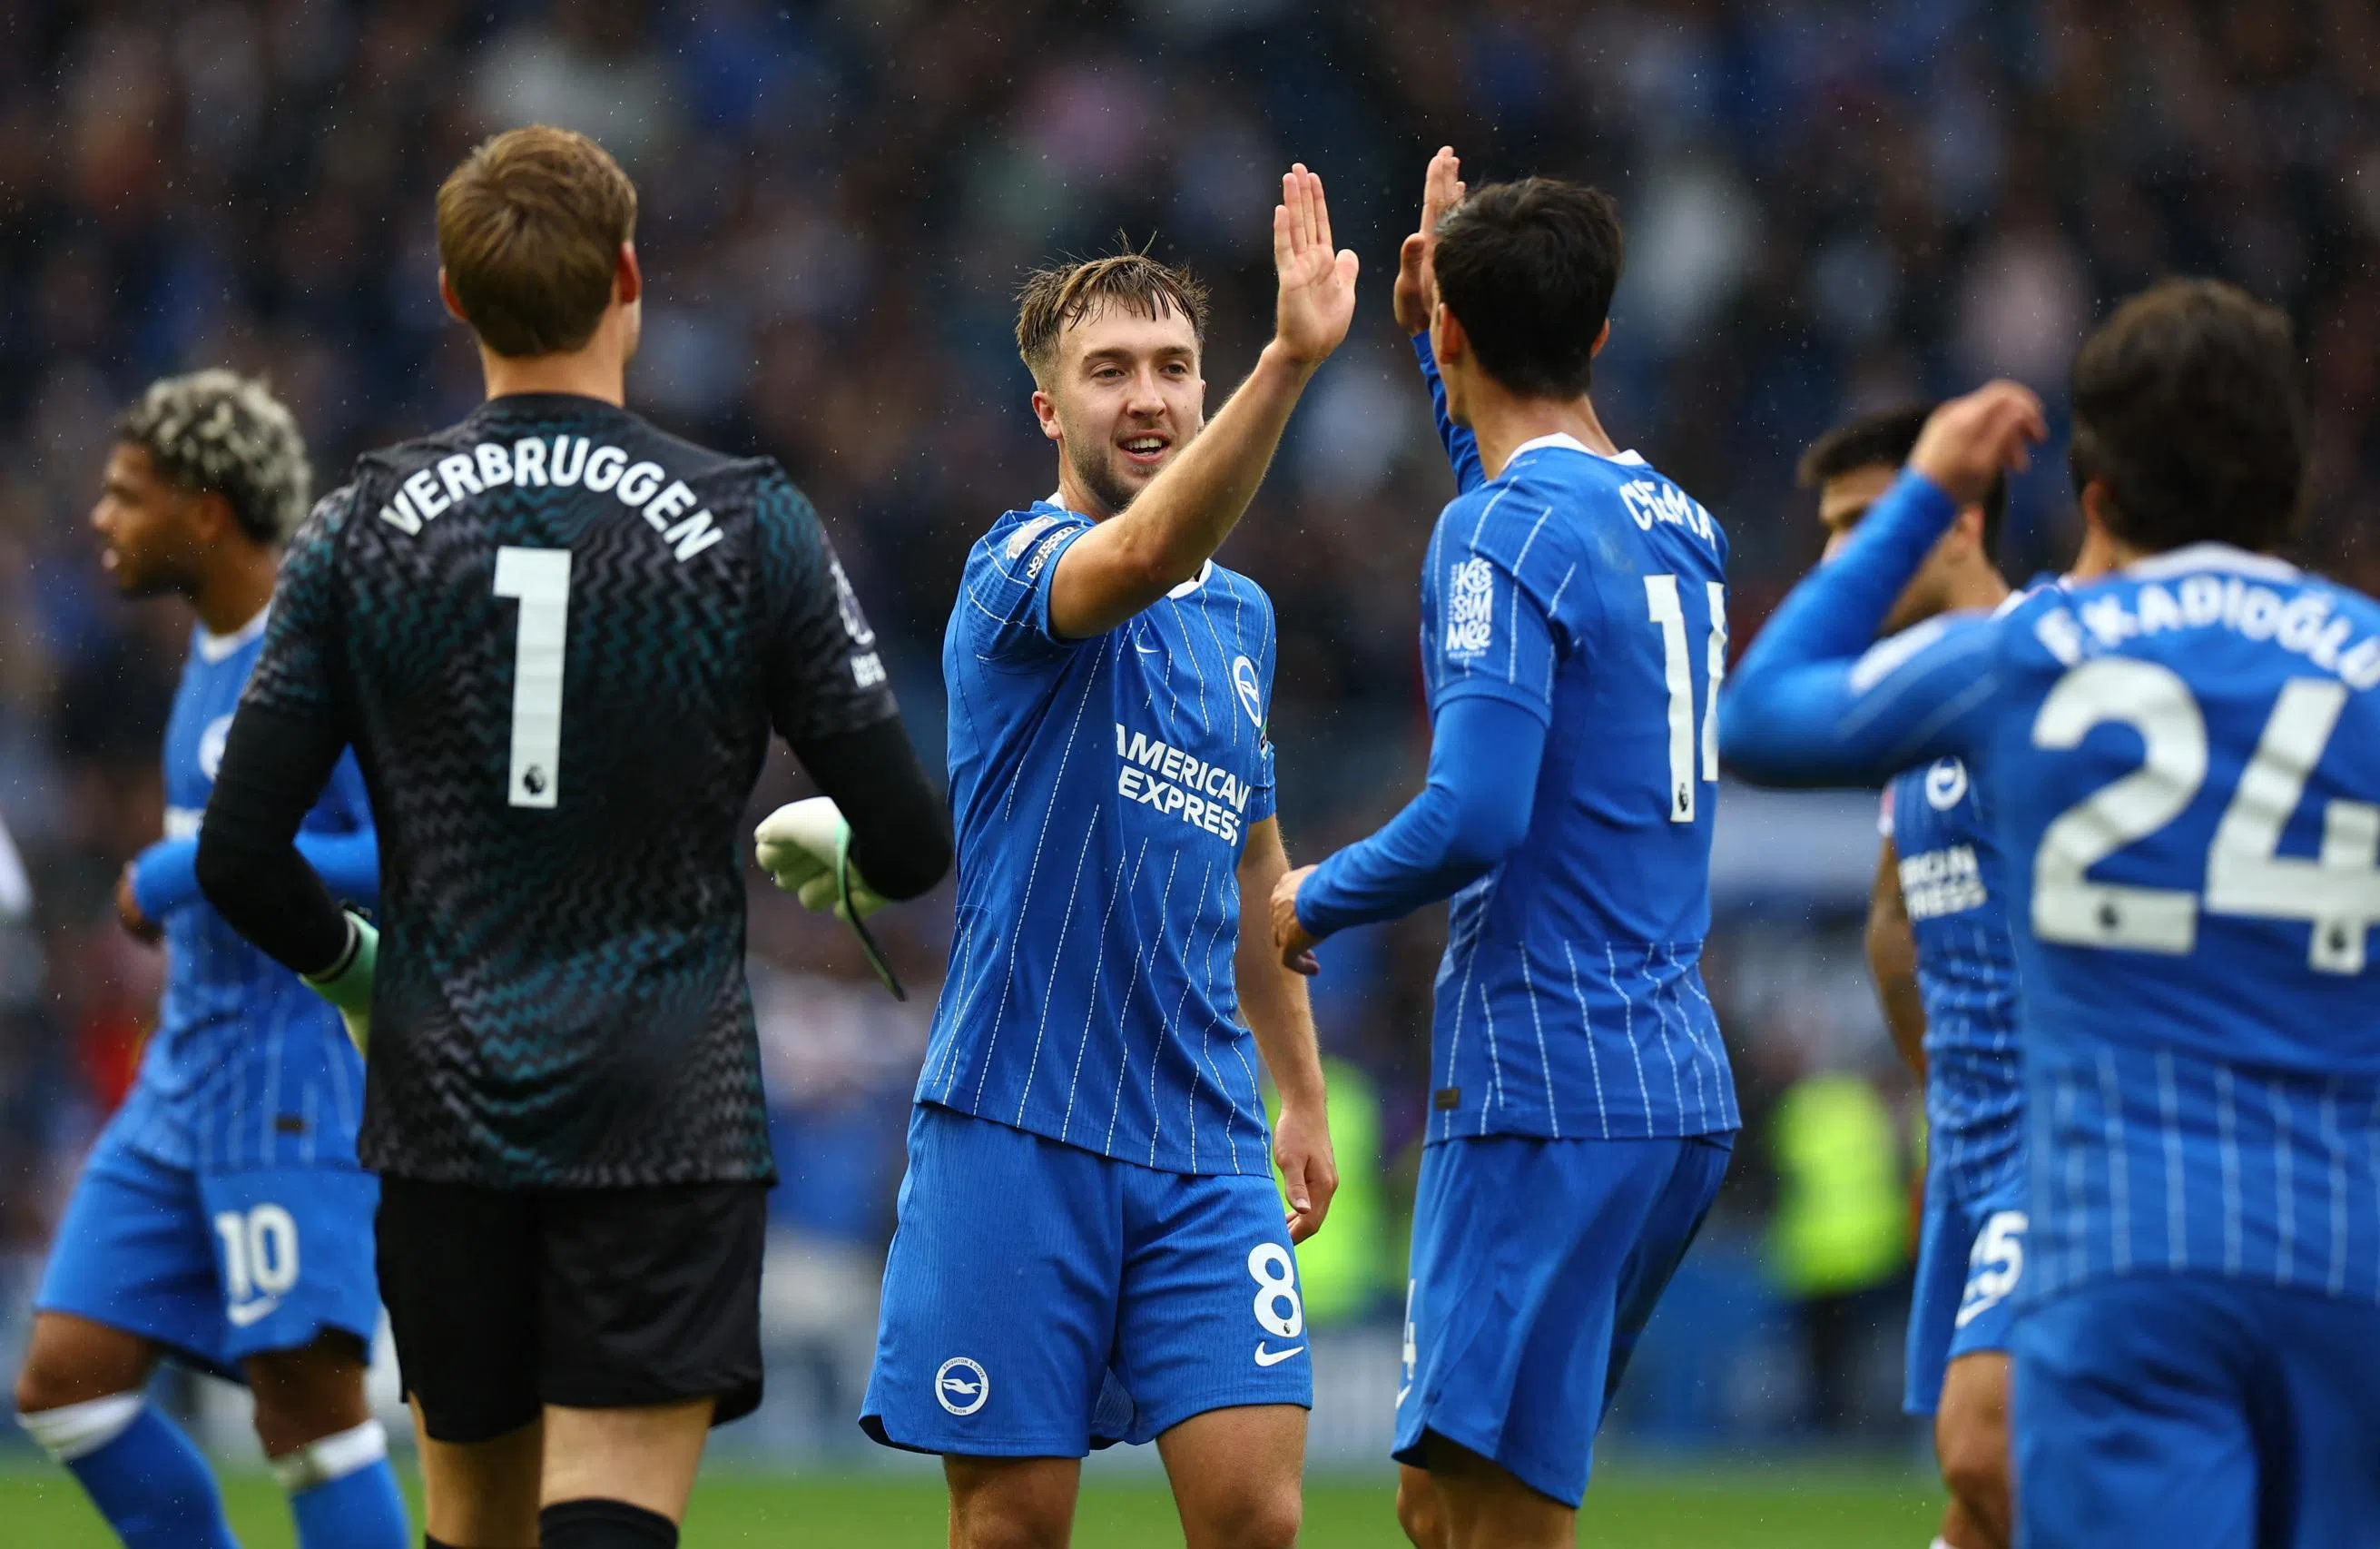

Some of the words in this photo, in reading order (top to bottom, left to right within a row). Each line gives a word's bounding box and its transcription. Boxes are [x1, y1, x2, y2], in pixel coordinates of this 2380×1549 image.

[379, 435, 723, 562] VERBRUGGEN
[493, 546, 572, 808] 1
[2031, 656, 2380, 975] 24
[214, 1203, 299, 1300] 10
[1247, 1242, 1303, 1338] 8
[947, 1406, 968, 1414] ALBION
